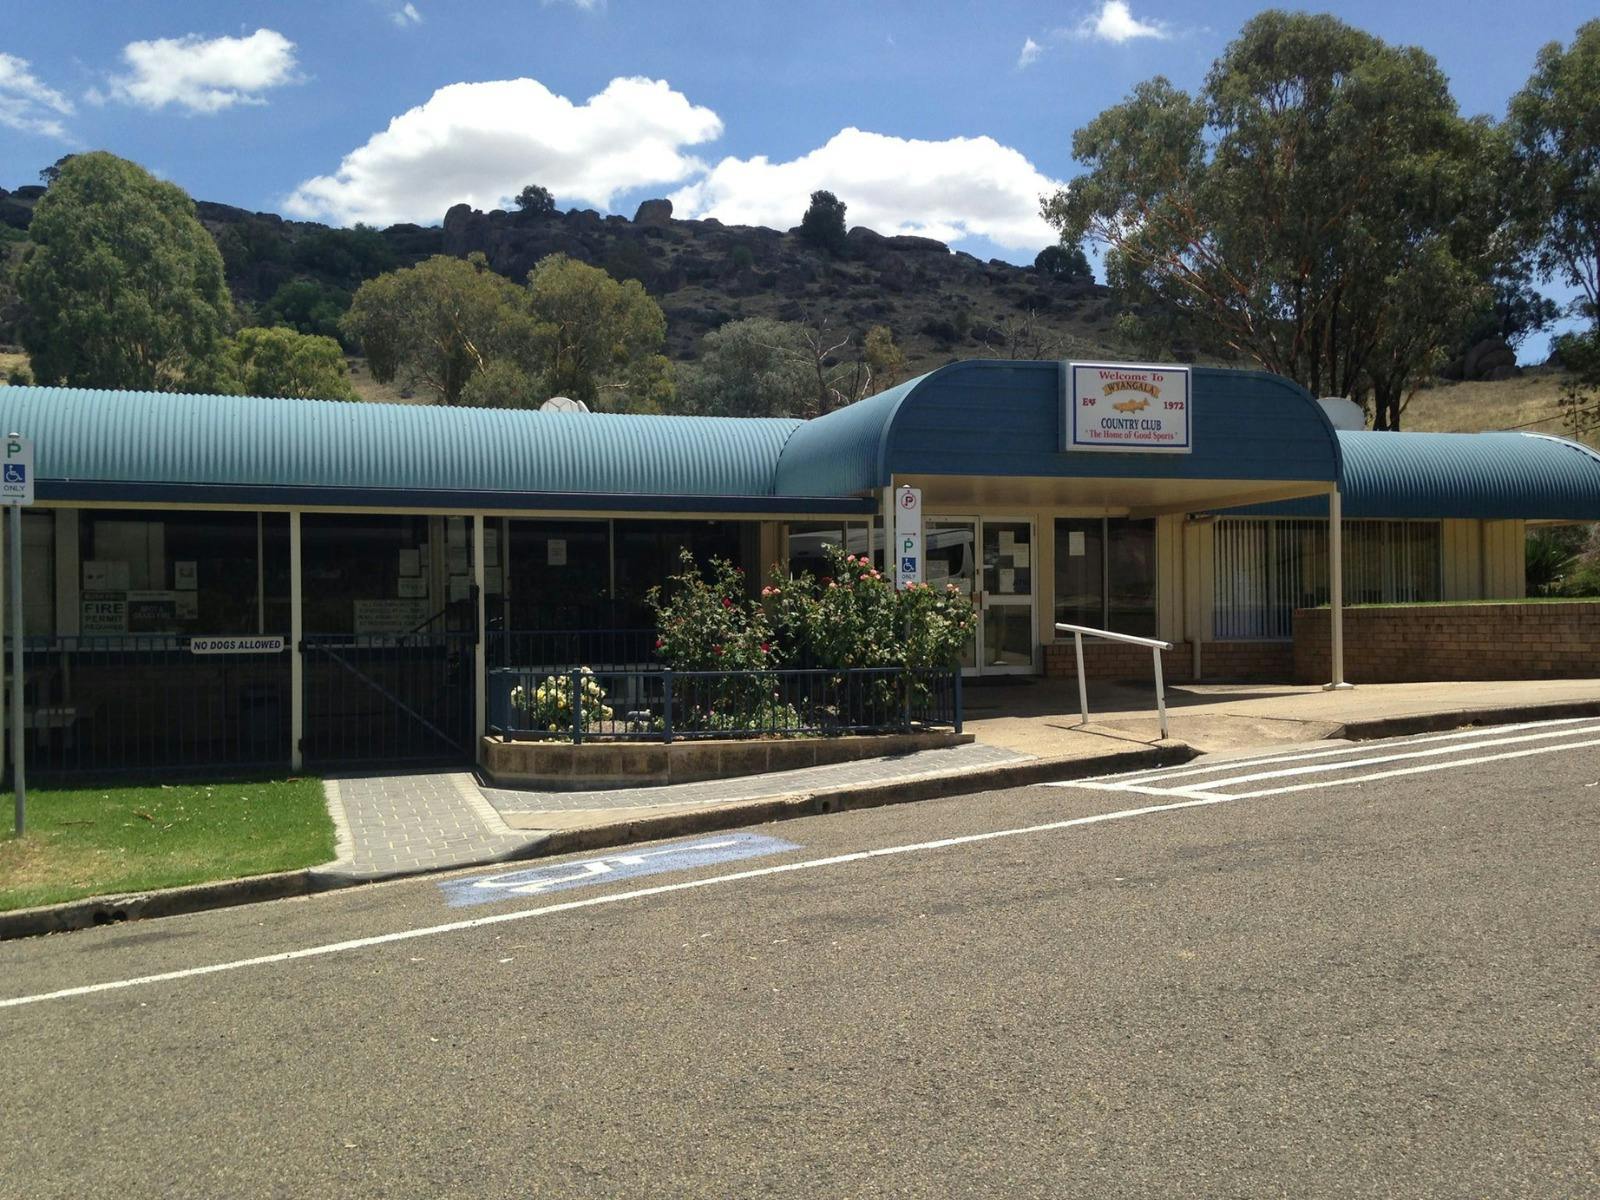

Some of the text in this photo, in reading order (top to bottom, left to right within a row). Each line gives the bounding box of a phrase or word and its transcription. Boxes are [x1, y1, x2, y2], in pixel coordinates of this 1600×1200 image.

[1099, 371, 1163, 382] Welcome To
[1107, 381, 1155, 394] WYANGALA
[1163, 401, 1185, 410] 1972
[1101, 418, 1162, 431] COUNTRY CLUB
[1103, 430, 1123, 439] Home
[1124, 431, 1132, 439] of
[1134, 431, 1151, 440] Good
[7, 443, 21, 458] P
[904, 540, 914, 553] P
[84, 603, 124, 614] FIRE
[193, 640, 281, 650] NO DOGS ALLOWED
